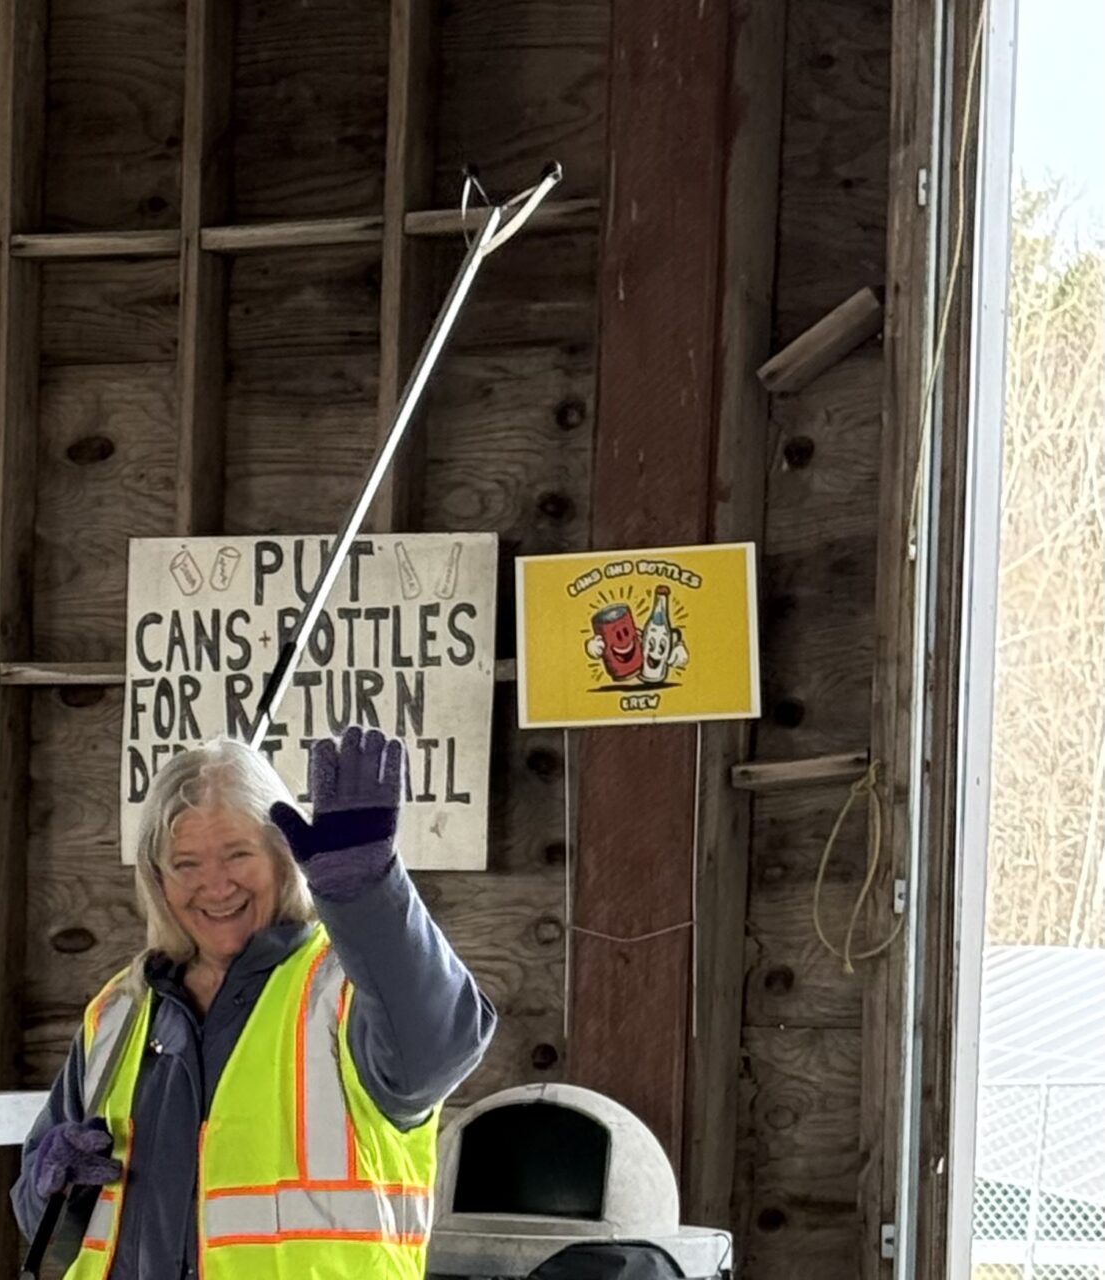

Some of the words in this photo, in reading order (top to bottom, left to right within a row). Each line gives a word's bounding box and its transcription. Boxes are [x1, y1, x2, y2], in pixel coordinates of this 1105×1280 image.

[567, 568, 603, 598] CANS
[604, 560, 634, 579] AND
[636, 559, 702, 589] BOTTLES
[129, 673, 202, 741] FOR
[620, 694, 661, 712] CREW
